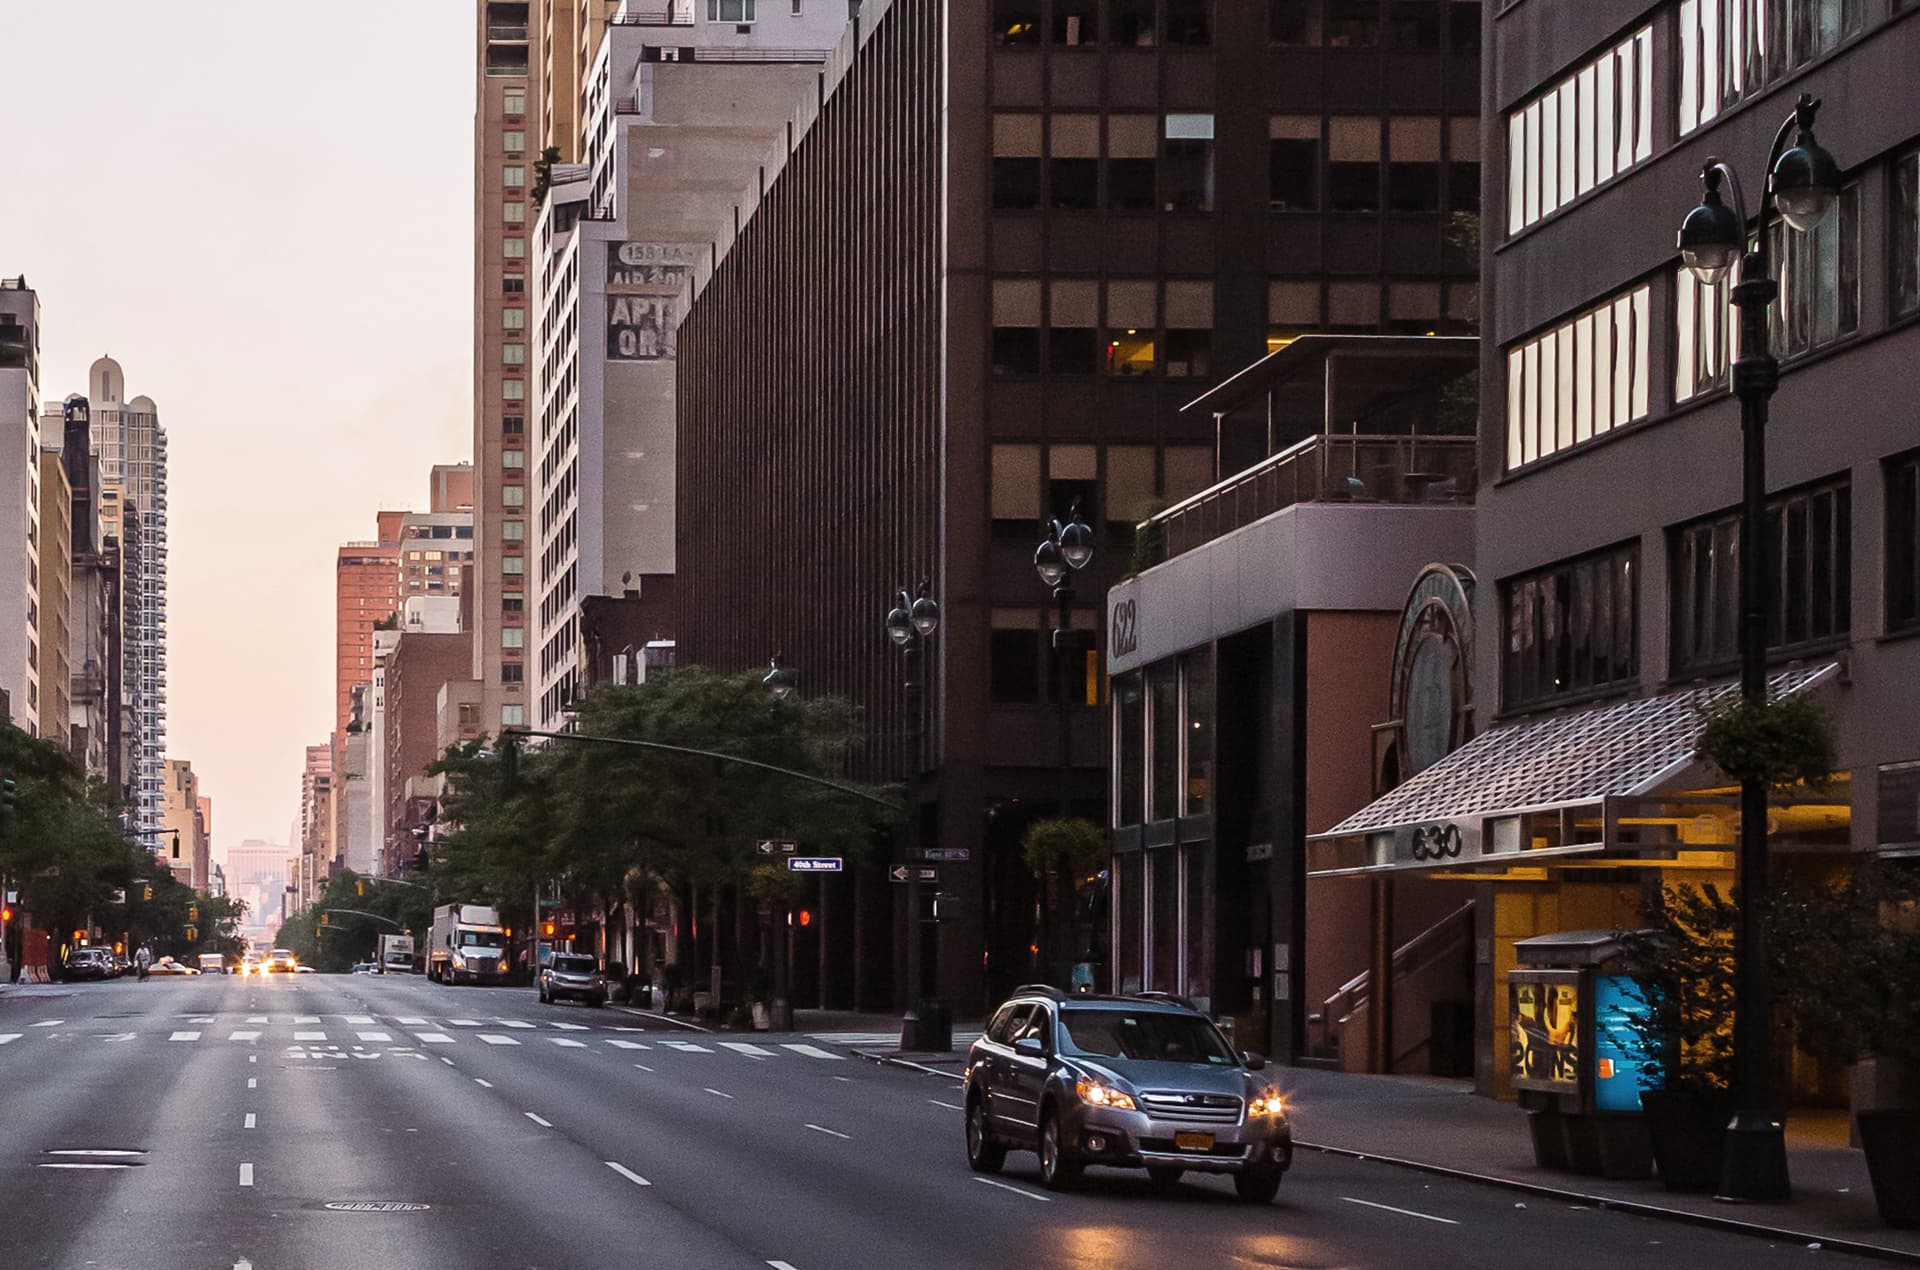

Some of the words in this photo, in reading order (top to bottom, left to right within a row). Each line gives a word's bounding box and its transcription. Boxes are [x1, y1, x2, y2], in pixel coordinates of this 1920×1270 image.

[1112, 598, 1137, 658] 622
[1412, 823, 1462, 861] 630
[813, 860, 837, 869] Street
